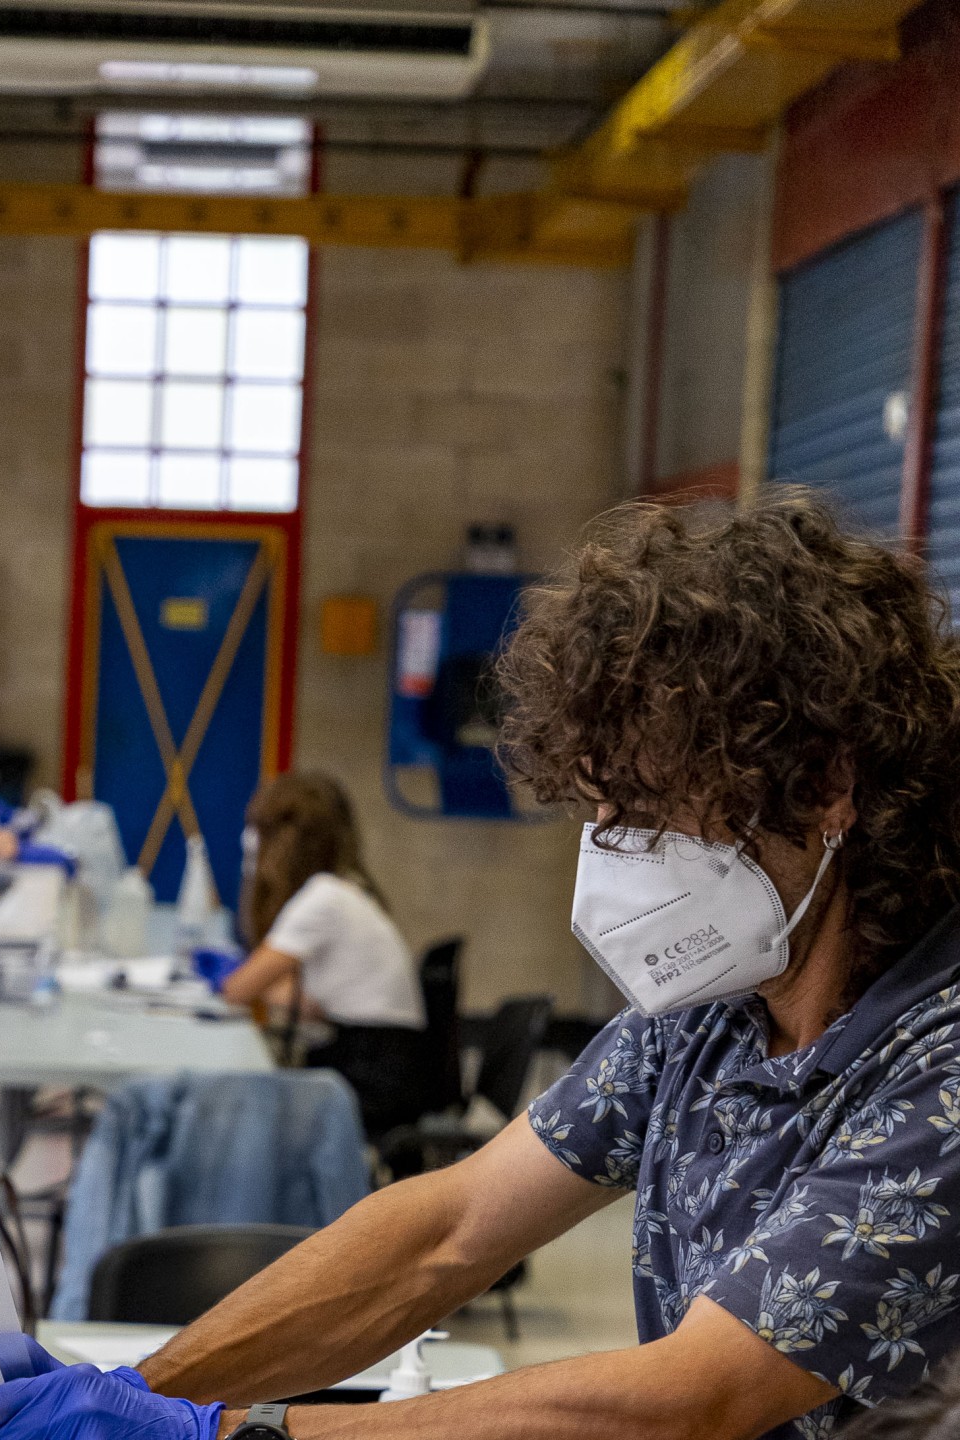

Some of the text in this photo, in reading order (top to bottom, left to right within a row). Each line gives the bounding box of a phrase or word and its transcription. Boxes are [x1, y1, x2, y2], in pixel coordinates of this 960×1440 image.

[650, 969, 663, 980] EN
[655, 968, 682, 987] FFP2
[681, 959, 697, 973] NR
